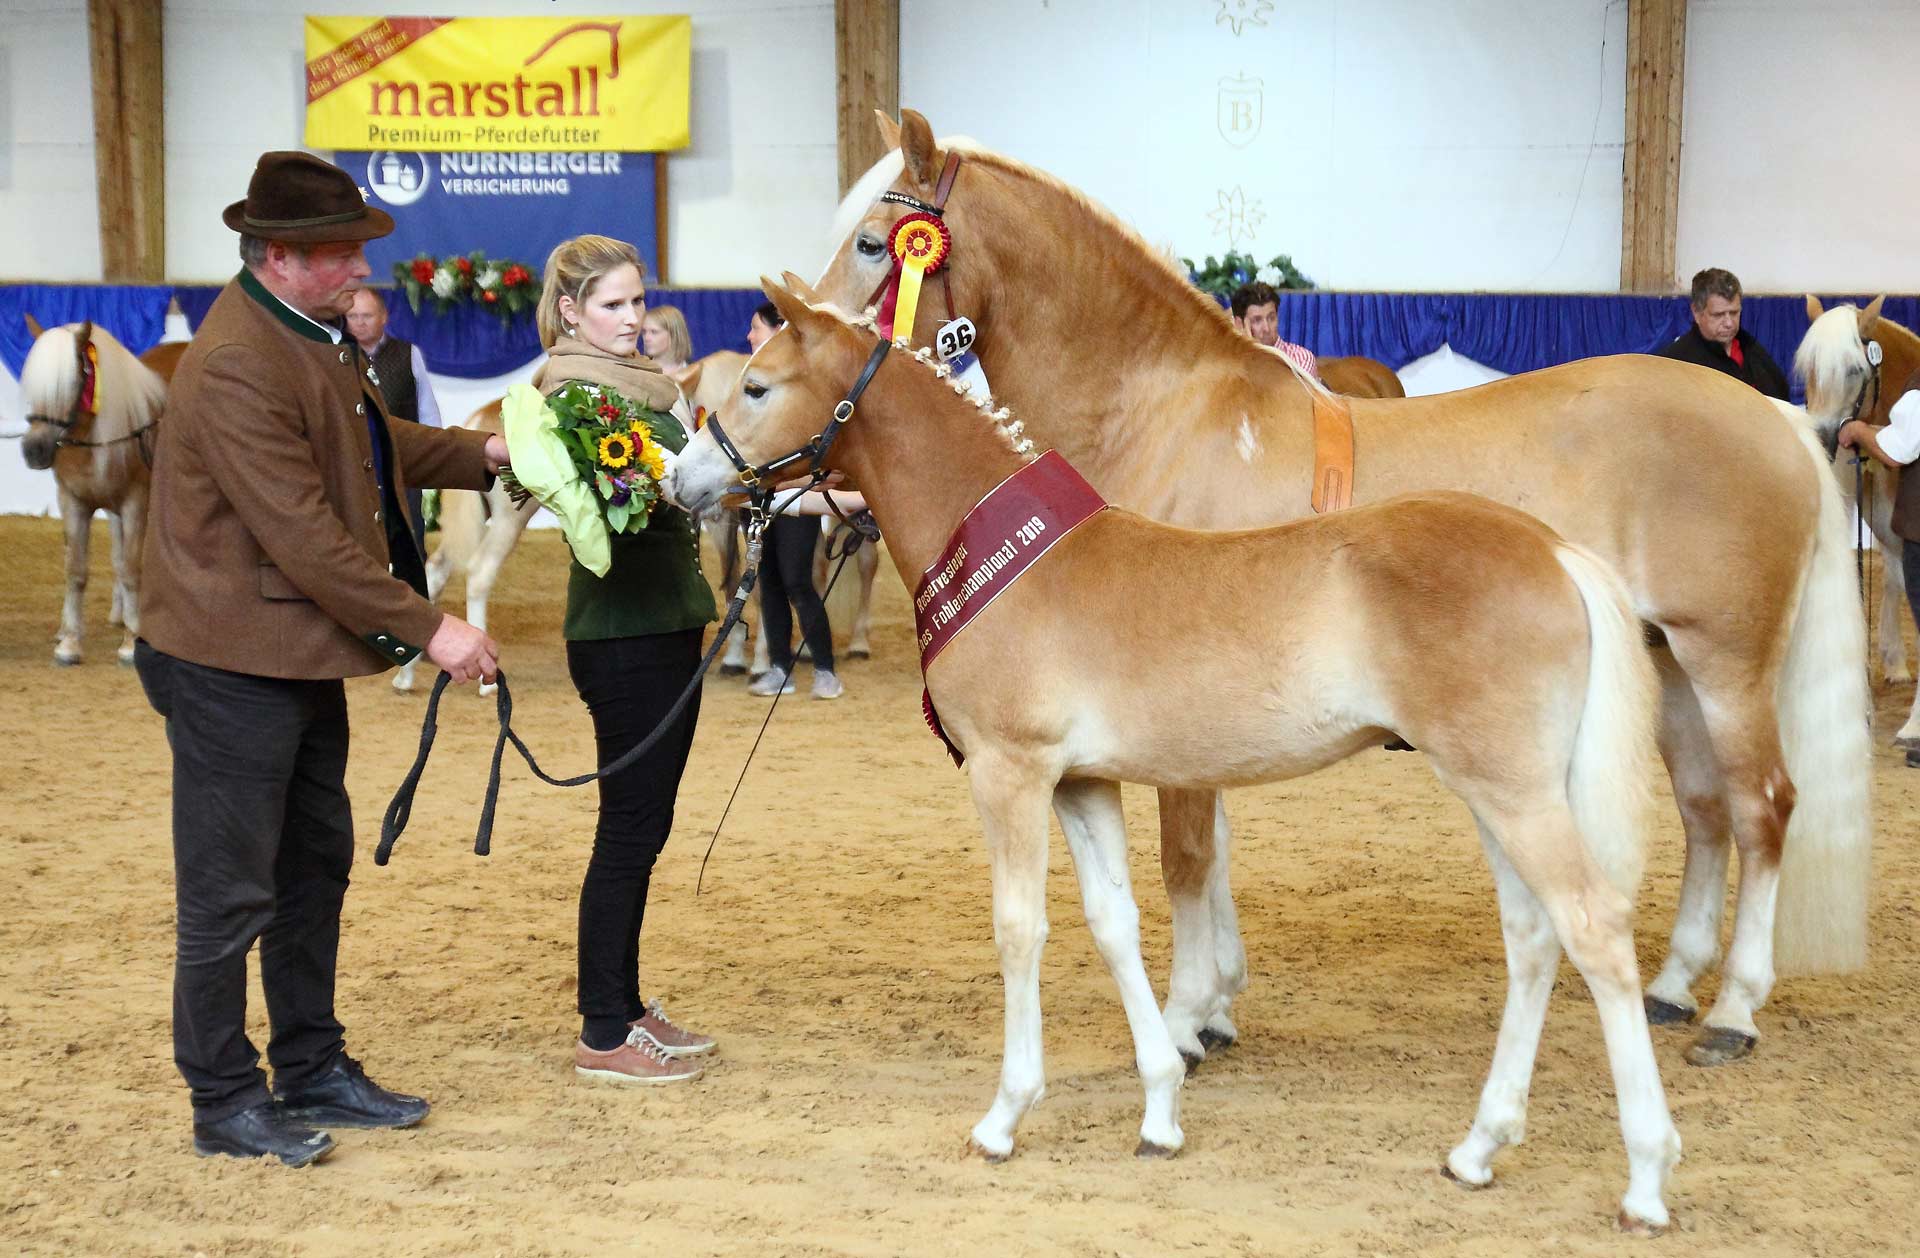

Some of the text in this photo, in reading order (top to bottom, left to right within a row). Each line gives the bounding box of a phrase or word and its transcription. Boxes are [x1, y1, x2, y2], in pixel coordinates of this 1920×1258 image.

[360, 19, 393, 47] Pferd
[309, 78, 332, 97] das
[373, 31, 409, 58] Futter
[368, 66, 600, 118] marstall
[368, 124, 600, 144] Premium-Pferdefutter
[441, 178, 570, 195] VERSICHERUNG
[941, 325, 972, 356] 36
[916, 541, 969, 614] Reservesieger
[931, 538, 1019, 631] Fohlenchampionat
[1015, 515, 1047, 547] 2019
